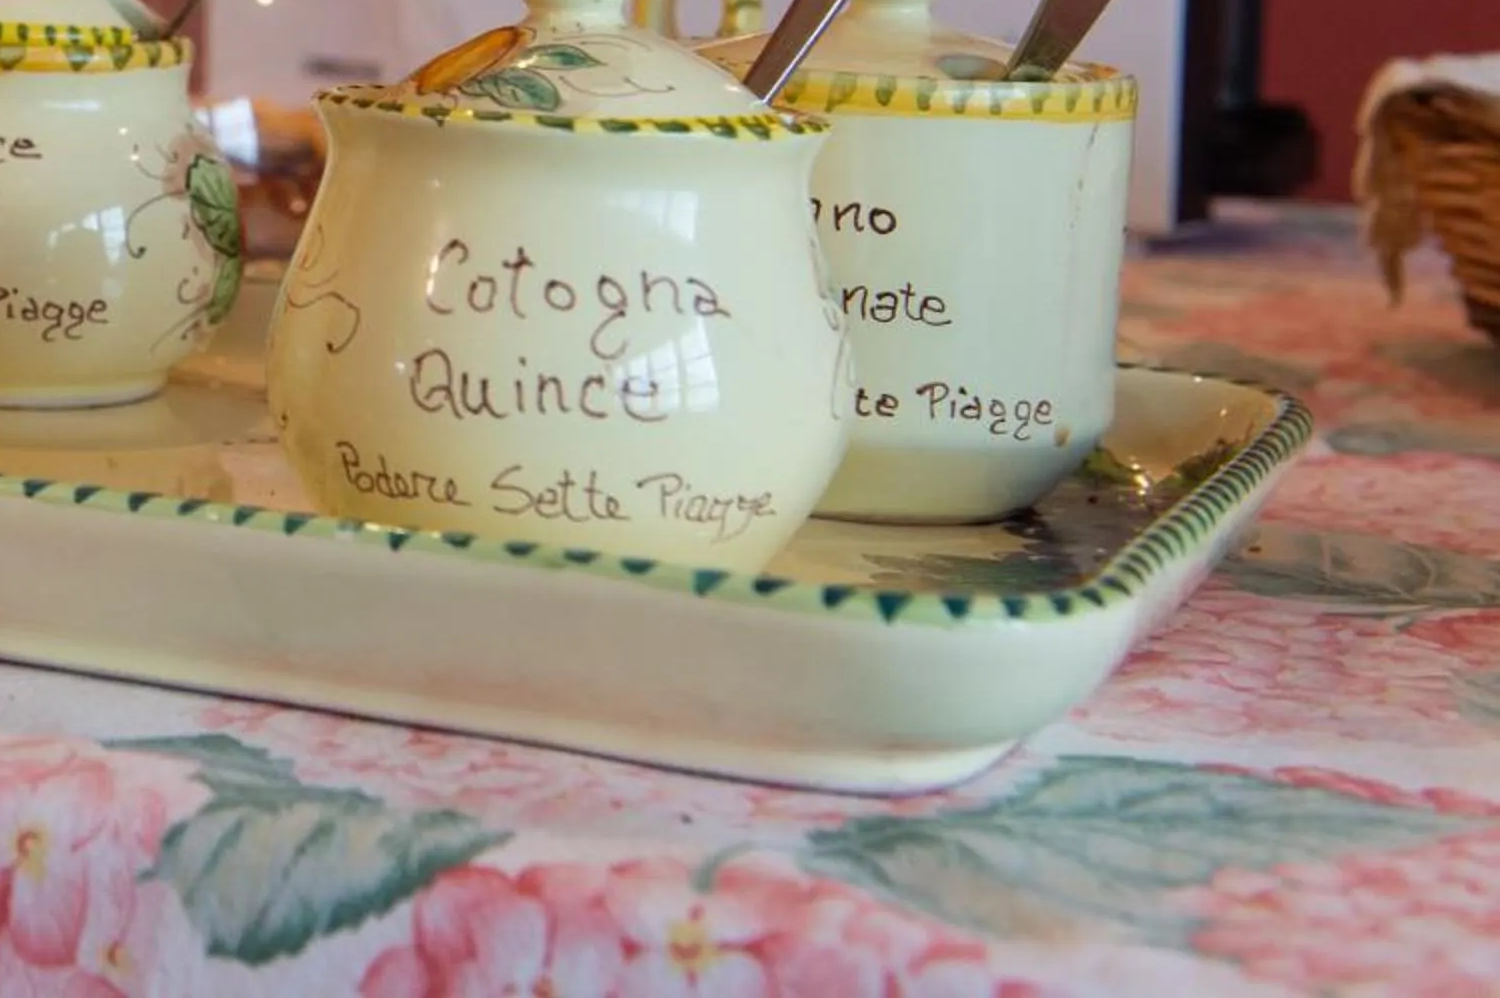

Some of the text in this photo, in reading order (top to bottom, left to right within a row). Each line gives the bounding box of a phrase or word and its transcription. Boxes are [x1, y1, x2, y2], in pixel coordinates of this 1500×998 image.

[426, 239, 731, 360] Cotogna
[841, 282, 952, 326] nate
[410, 349, 668, 422] Quince
[854, 382, 1053, 441] te Piagge
[490, 465, 632, 523] Sette
